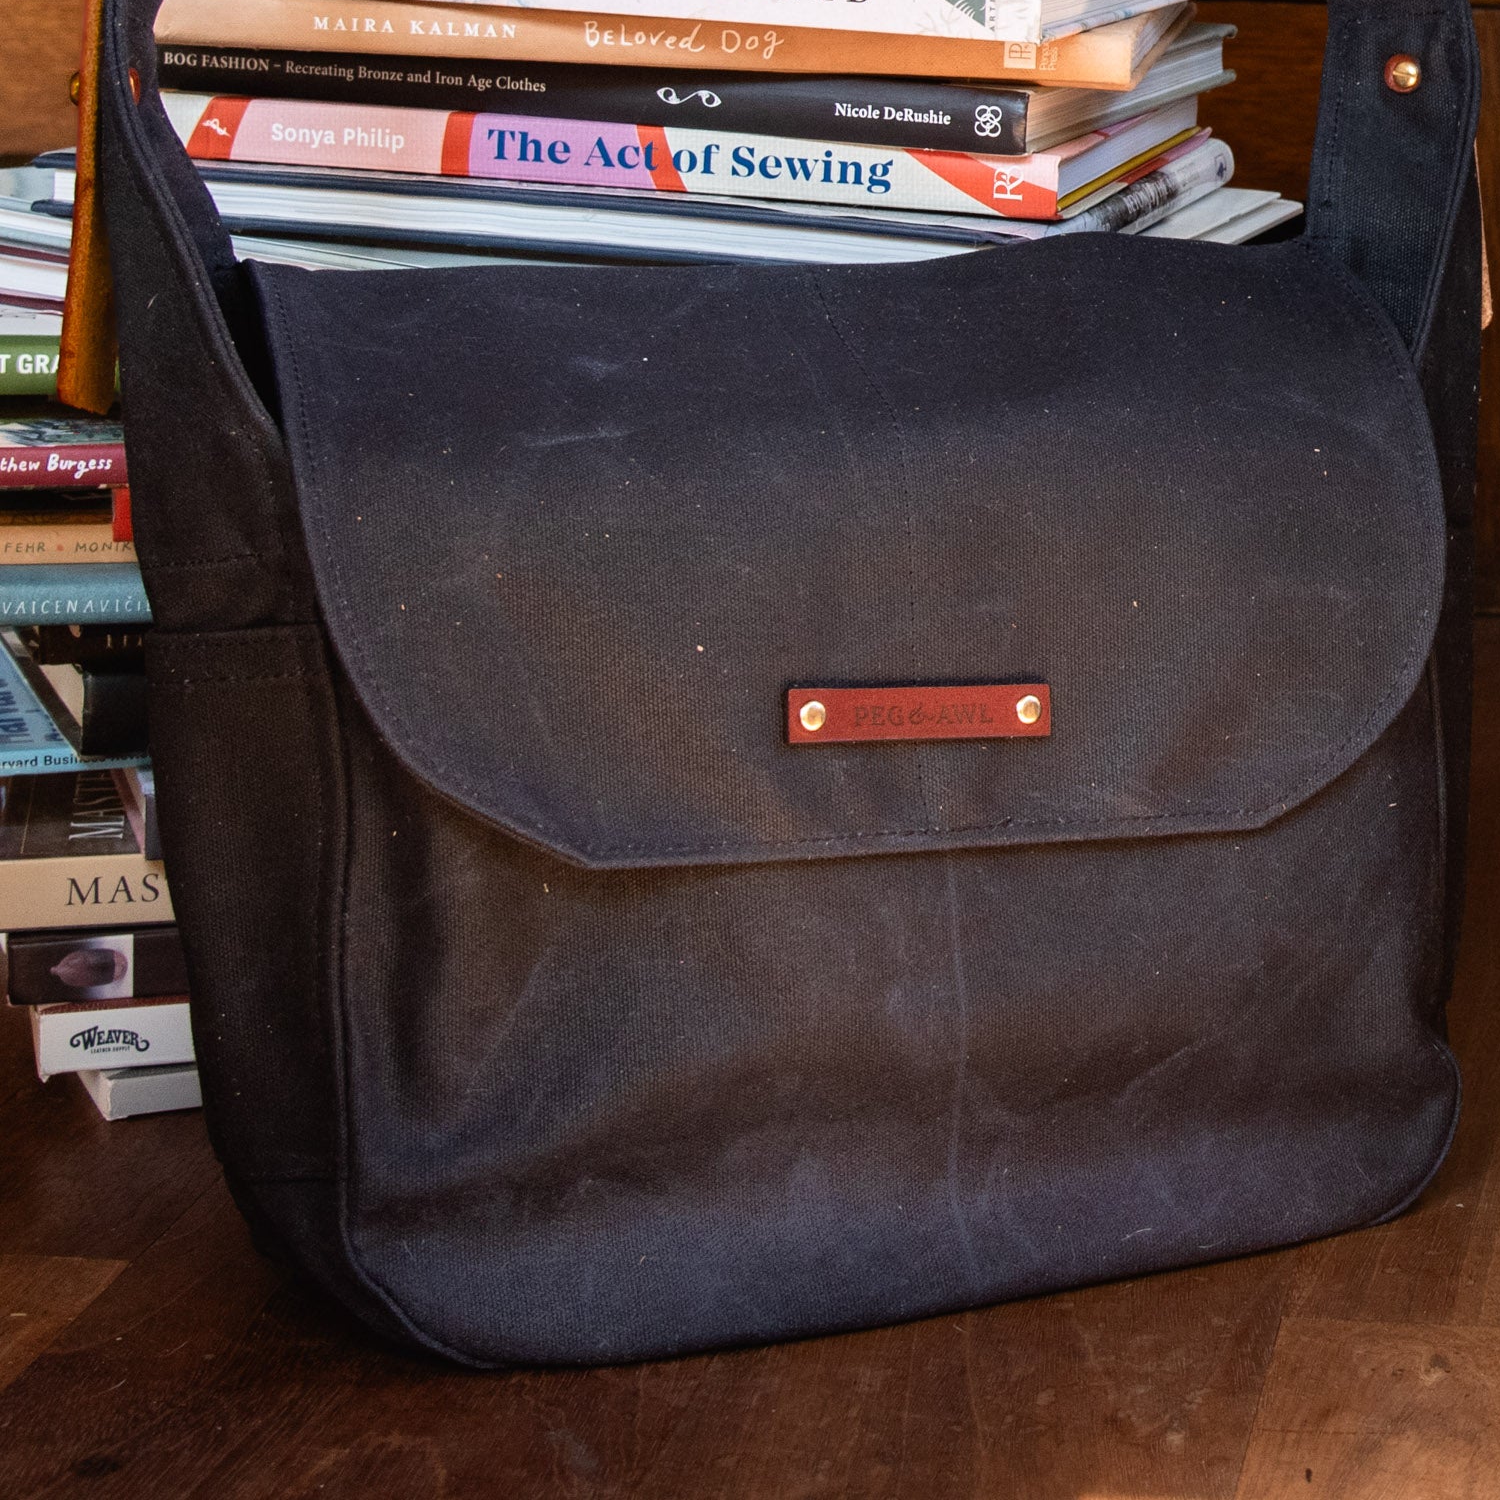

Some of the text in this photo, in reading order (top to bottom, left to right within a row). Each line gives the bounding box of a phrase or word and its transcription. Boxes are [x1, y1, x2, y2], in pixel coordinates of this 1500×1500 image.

[313, 16, 517, 39] MAIRA KALMAN
[164, 52, 547, 94] BOG FASHION Recreating Bronze and Iron Age Clothes
[834, 102, 951, 127] Nicole DeRushie
[271, 121, 405, 152] Sonya Philip
[487, 128, 895, 194] The Act of Sewing
[46, 453, 113, 479] Burgess
[70, 1025, 150, 1052] WEAVER
